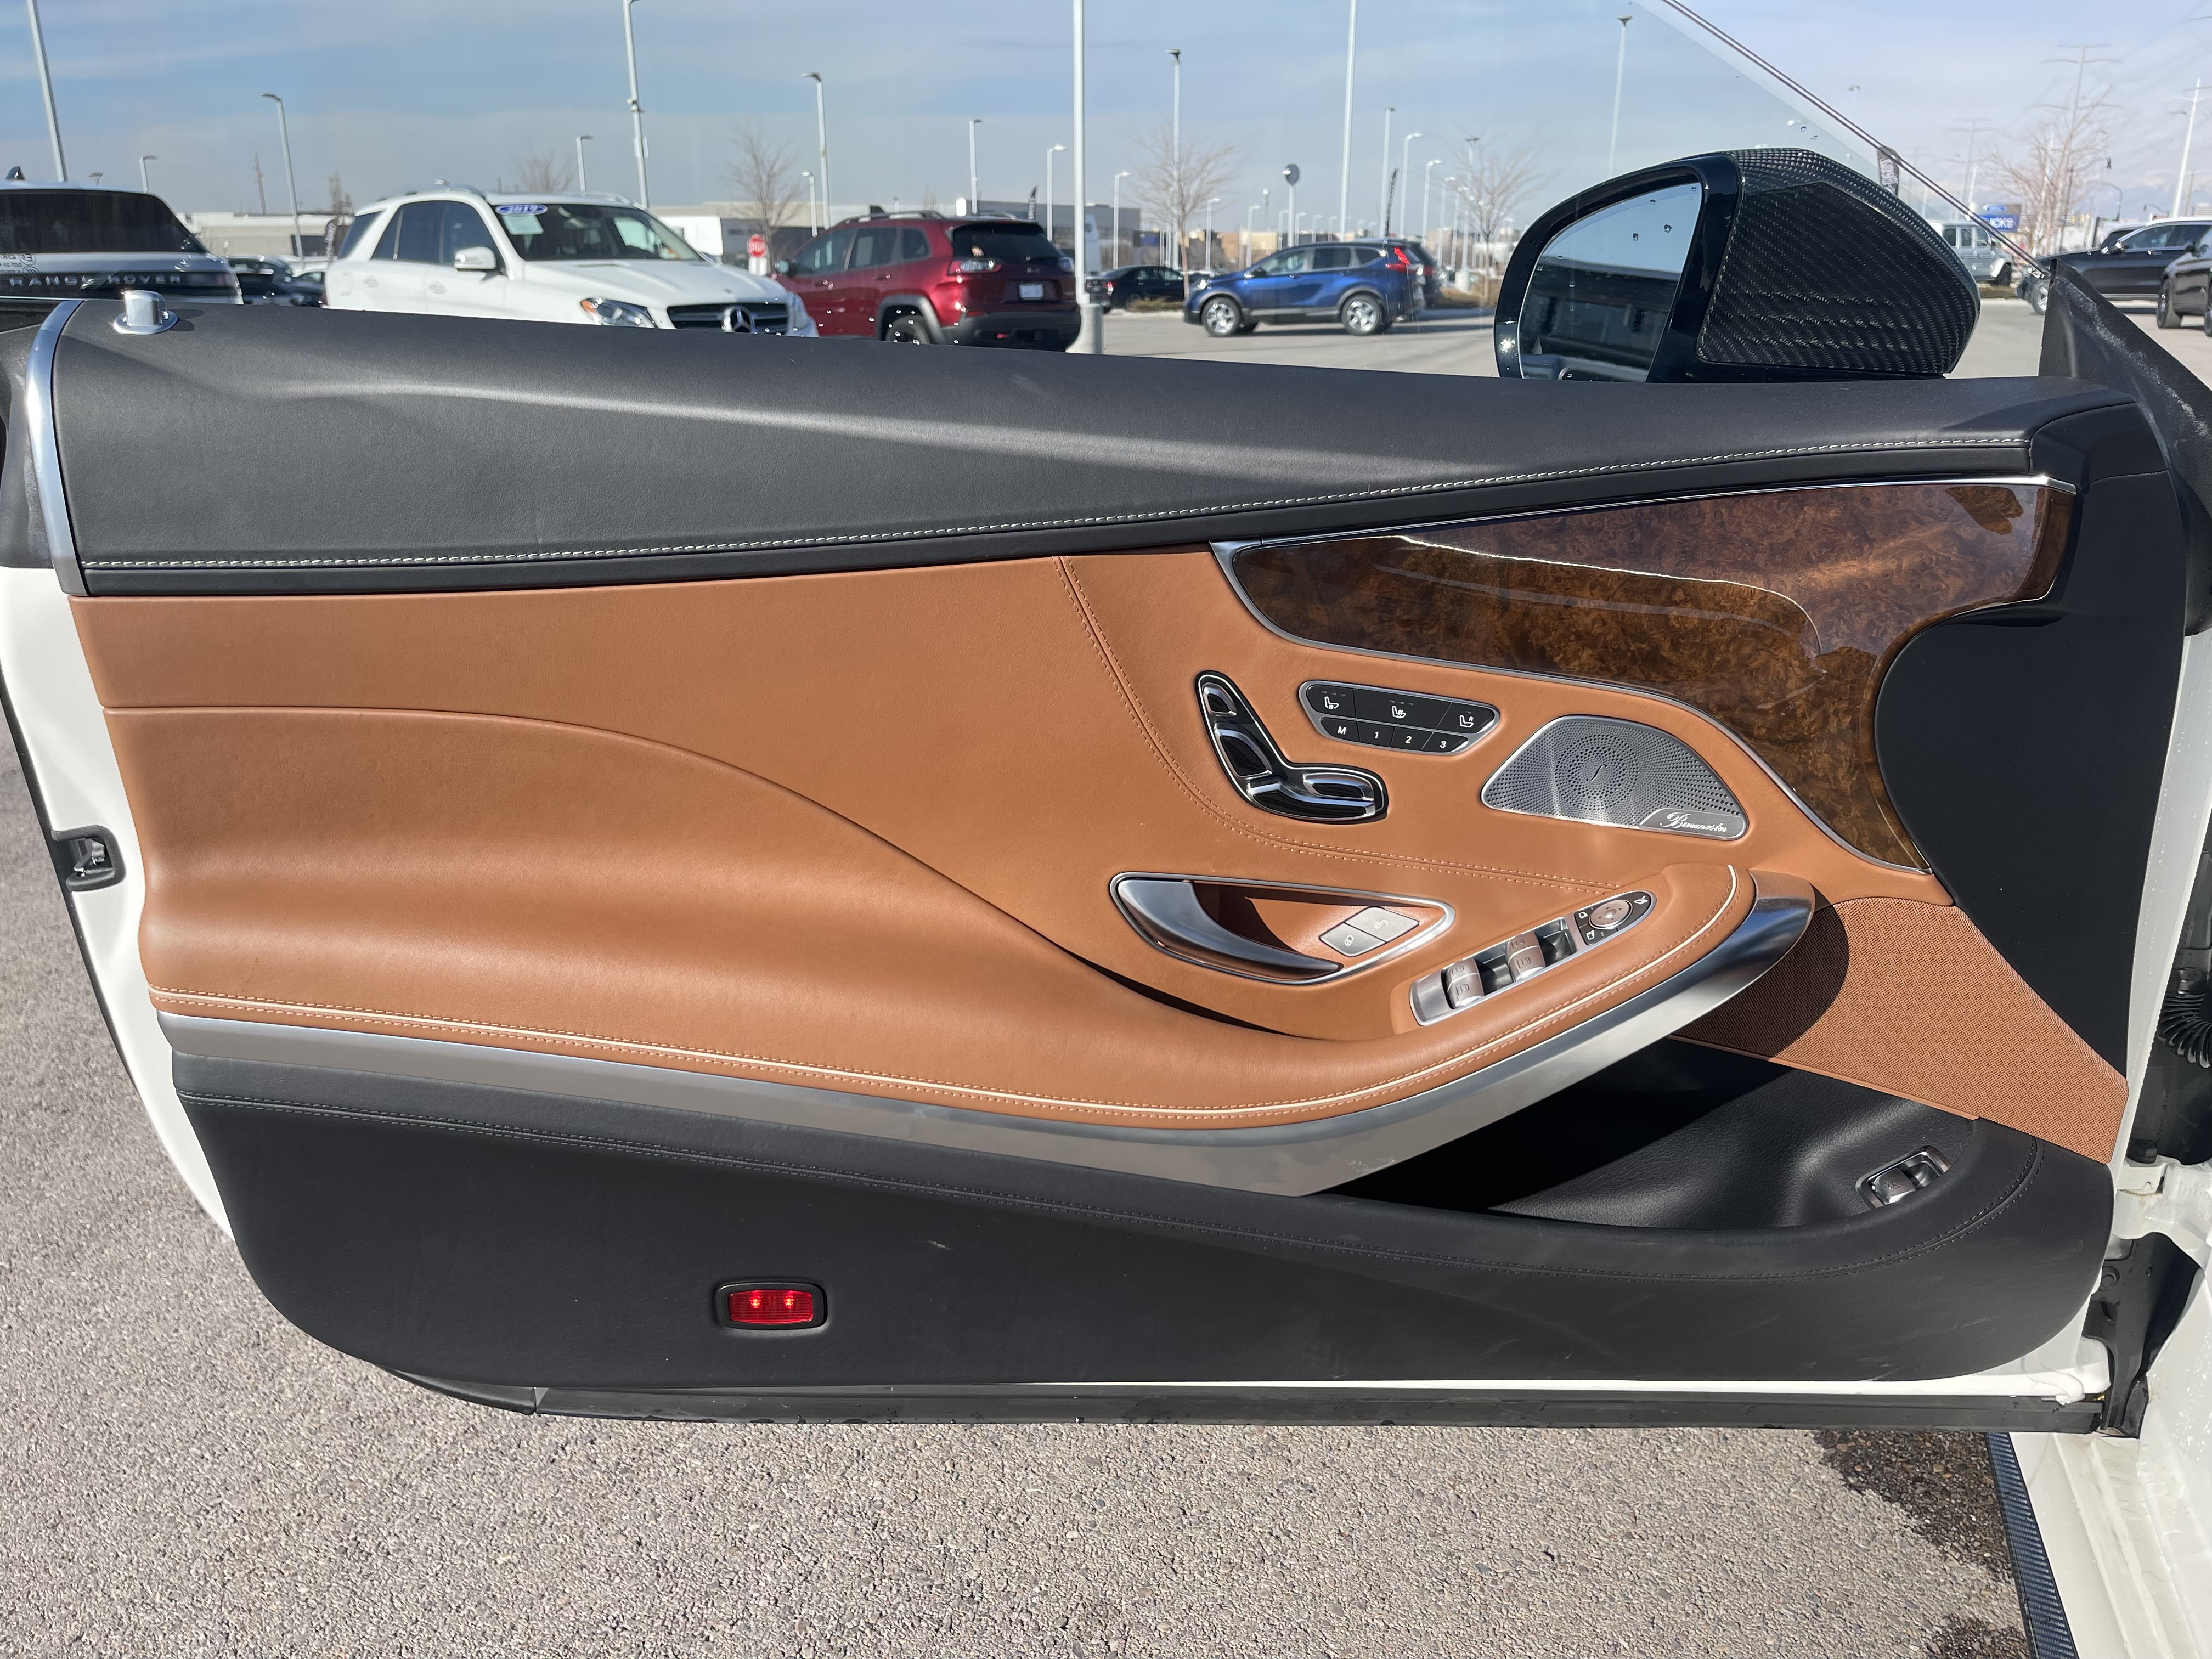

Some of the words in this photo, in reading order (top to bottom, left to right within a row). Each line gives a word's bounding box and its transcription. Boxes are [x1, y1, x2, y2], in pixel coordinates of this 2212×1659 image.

[749, 242, 765, 251] STOP
[107, 274, 182, 285] ROVER
[1337, 726, 1347, 735] M
[1404, 736, 1412, 744] 2
[1440, 740, 1447, 748] 3
[1659, 812, 1728, 832] Burmester
